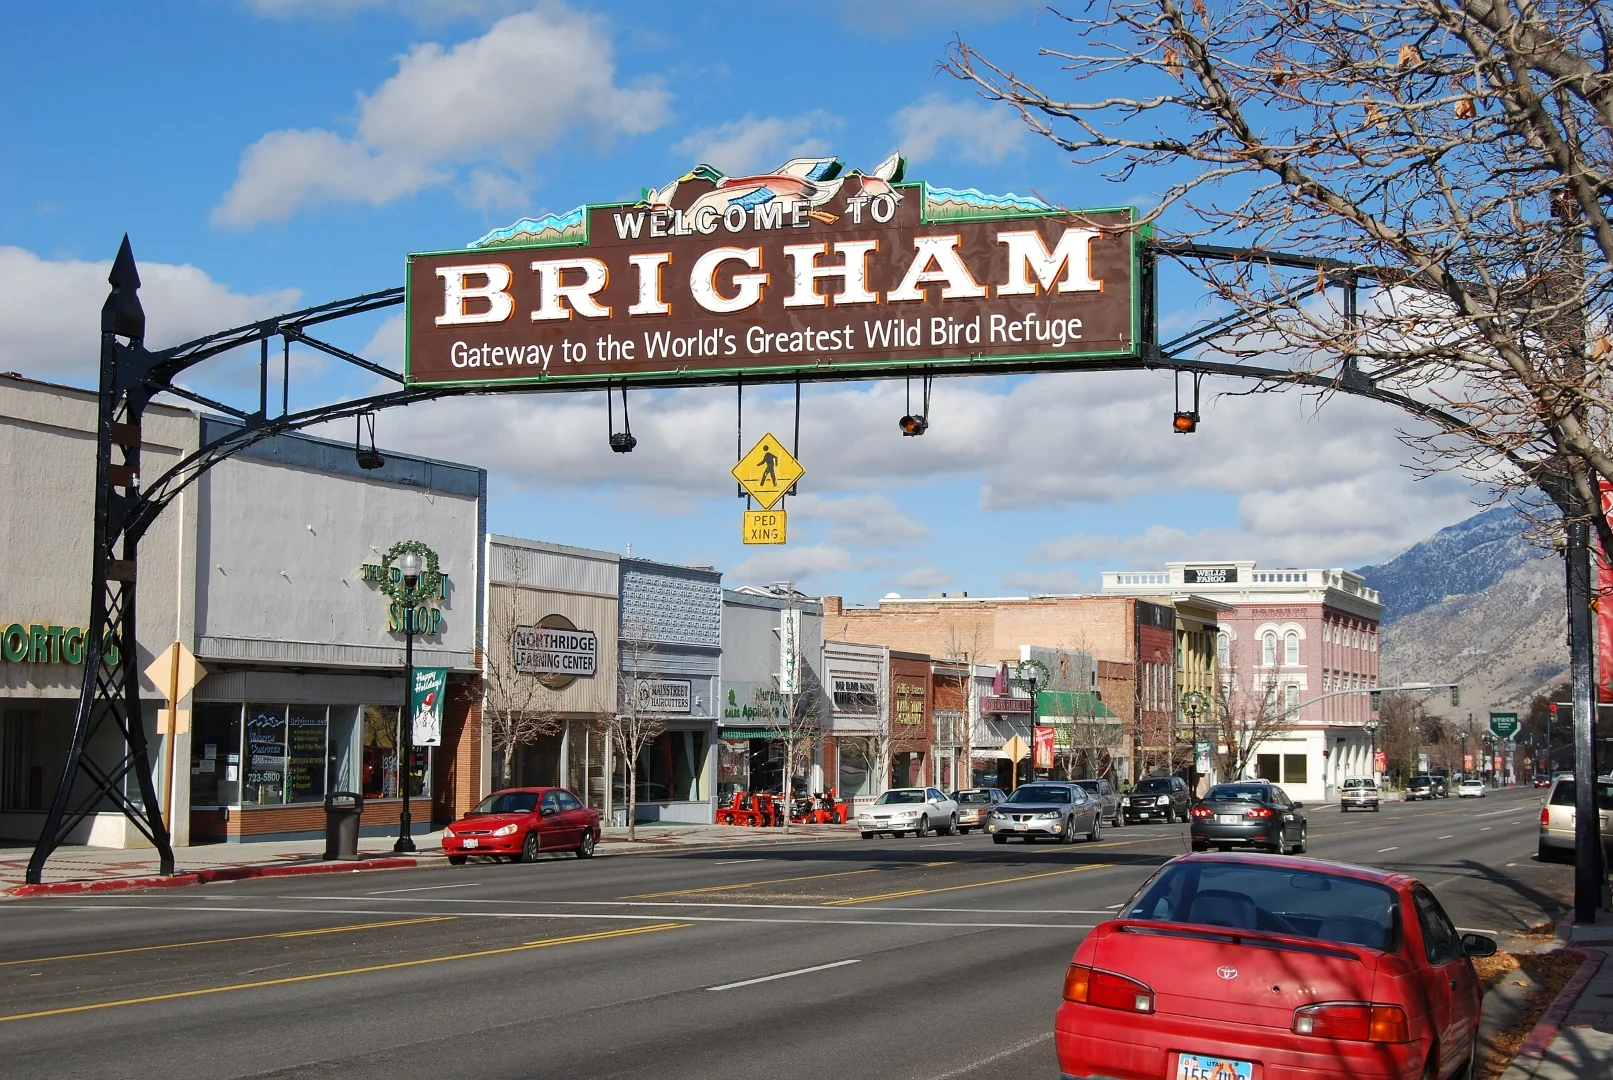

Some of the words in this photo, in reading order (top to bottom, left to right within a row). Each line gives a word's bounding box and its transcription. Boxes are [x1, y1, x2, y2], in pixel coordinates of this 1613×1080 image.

[613, 200, 812, 241] WELCOME
[845, 193, 896, 225] TO
[434, 227, 1104, 328] BRIGHAM
[450, 341, 554, 370] Gateway
[562, 338, 587, 363] to
[596, 333, 635, 361] the
[644, 327, 737, 358] World's
[746, 325, 855, 354] Greatest
[864, 317, 921, 349] Wild
[930, 314, 980, 345] Bird
[990, 312, 1082, 347] Refuge
[753, 515, 776, 526] PED
[751, 528, 778, 540] XING
[1196, 569, 1227, 577] WELLS
[386, 602, 442, 635] SHOP
[516, 632, 595, 651] NORTHRIDGE
[516, 652, 560, 668] LEARNING
[562, 655, 594, 670] CENTER
[415, 671, 437, 682] Happy
[414, 679, 442, 693] Holidays
[651, 684, 689, 697] MAINSTREET
[651, 697, 689, 708] HAIRCUTTERS
[248, 773, 280, 782] 723-5800
[1206, 1060, 1224, 1068] UTAH
